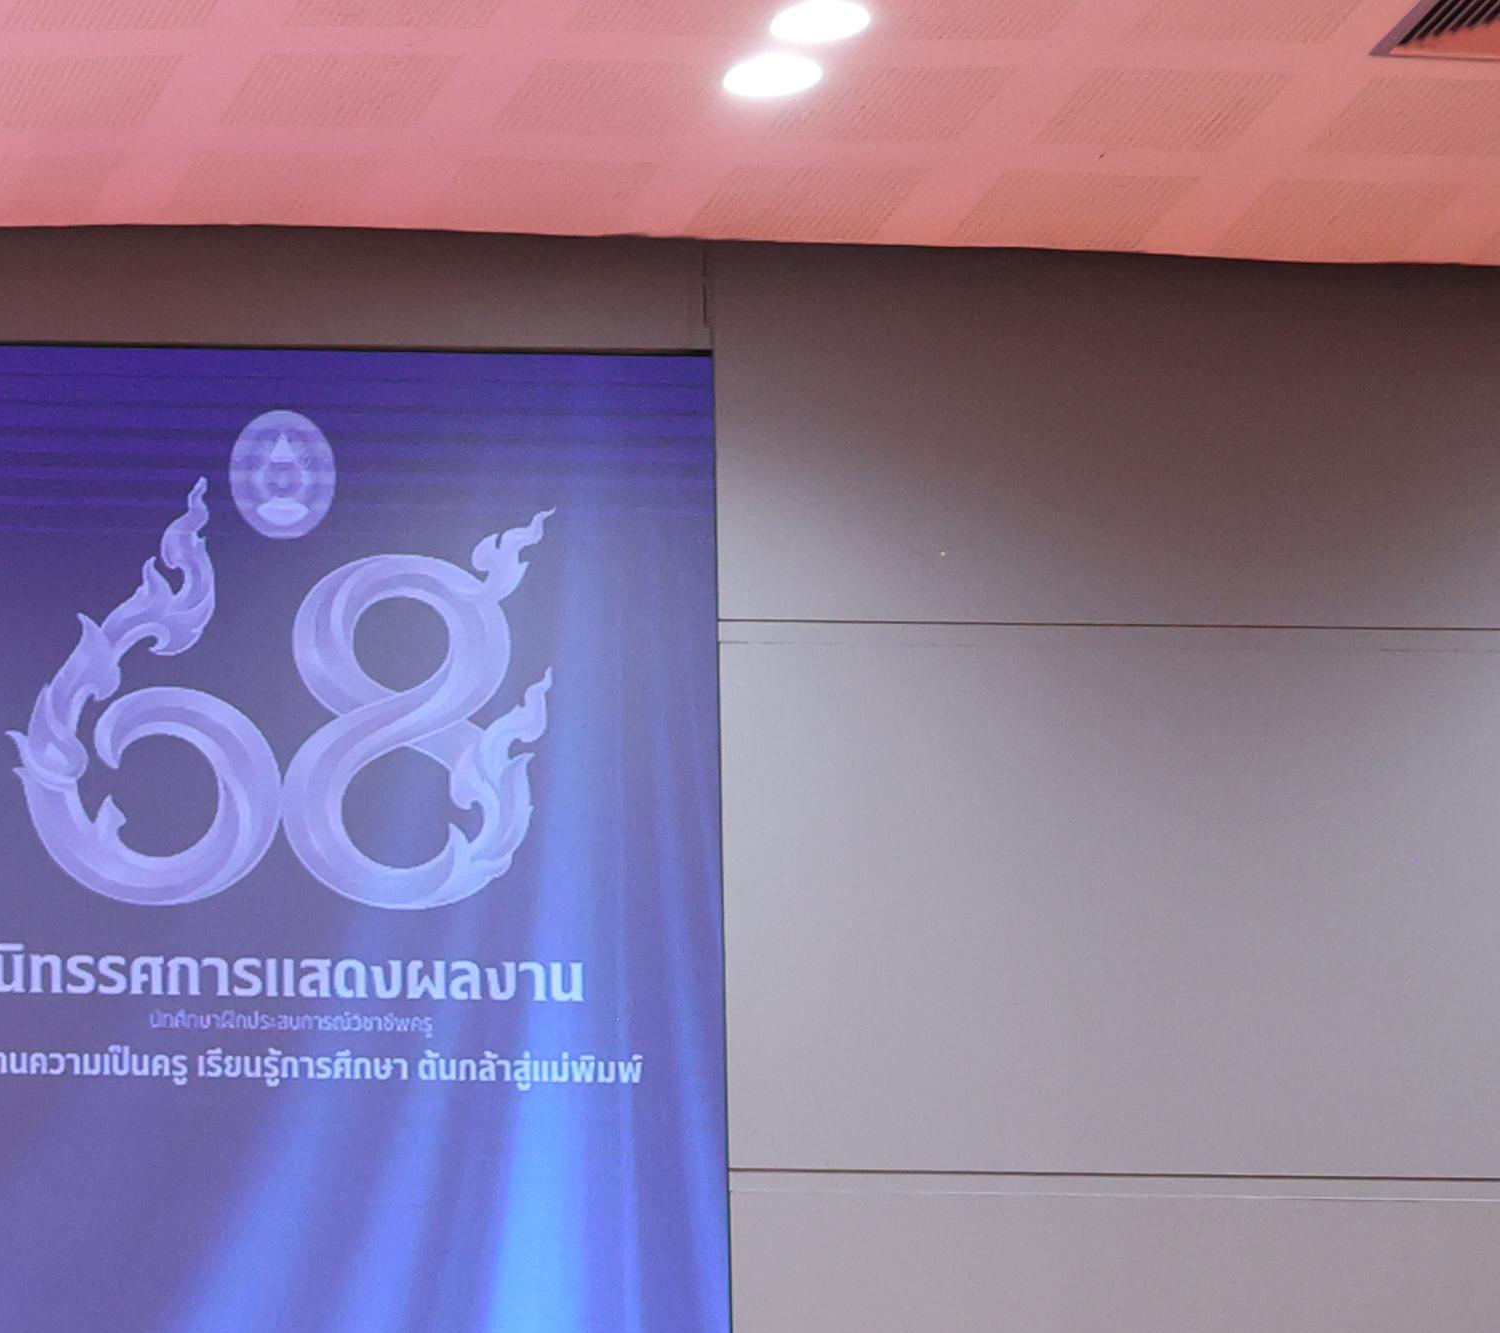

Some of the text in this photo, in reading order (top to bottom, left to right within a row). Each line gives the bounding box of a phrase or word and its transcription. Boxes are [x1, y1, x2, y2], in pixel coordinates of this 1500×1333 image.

[198, 1046, 408, 1087] เรียนรู้การศึกษา
[418, 1050, 643, 1091] ต้นกล้าสู่แม่พิมพ์
